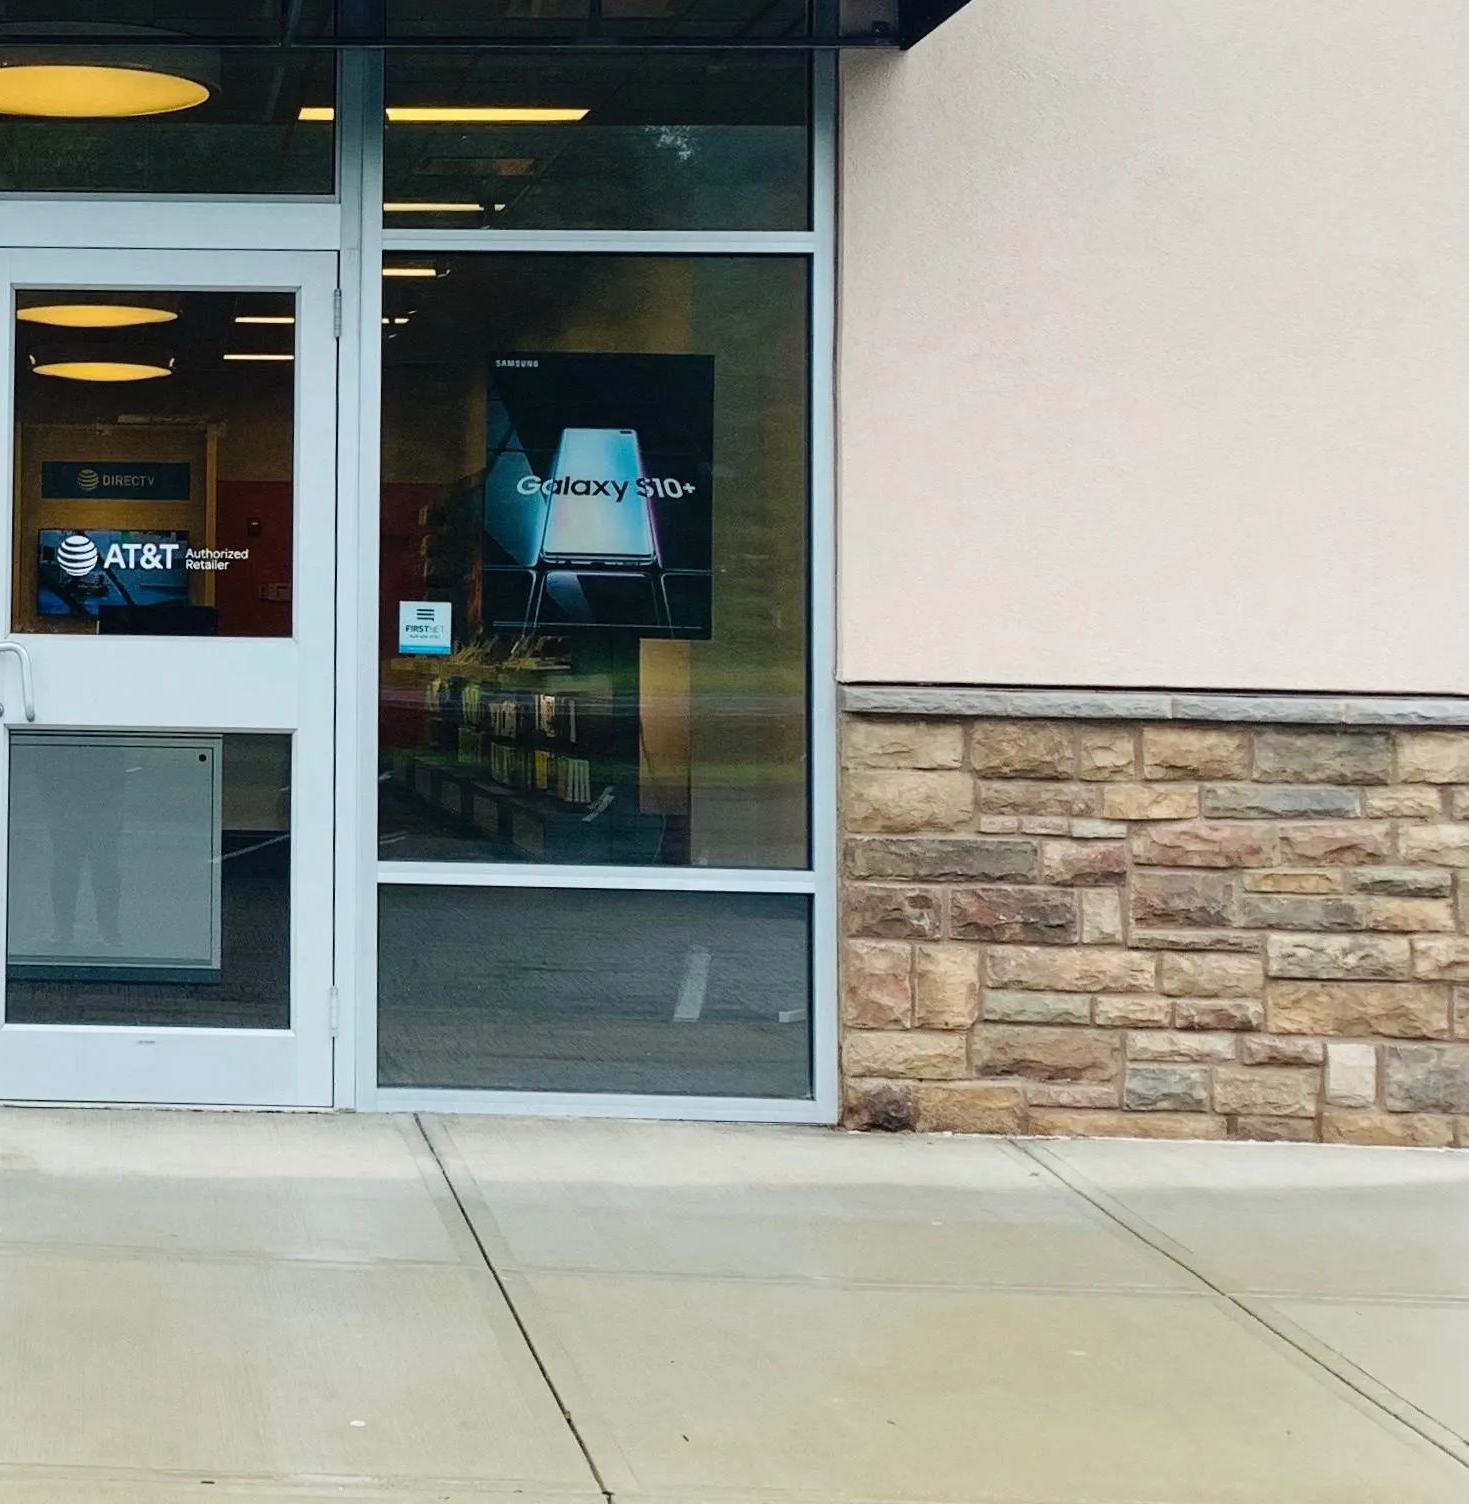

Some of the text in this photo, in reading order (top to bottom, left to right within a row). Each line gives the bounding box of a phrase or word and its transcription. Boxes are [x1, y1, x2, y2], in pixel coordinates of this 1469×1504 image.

[496, 359, 539, 368] SAMSUNG
[102, 474, 155, 486] DIRECTV
[516, 475, 696, 502] Galaxy S10+
[103, 543, 180, 570] AT&T
[185, 548, 249, 560] Authorized
[185, 559, 229, 571] Retailer
